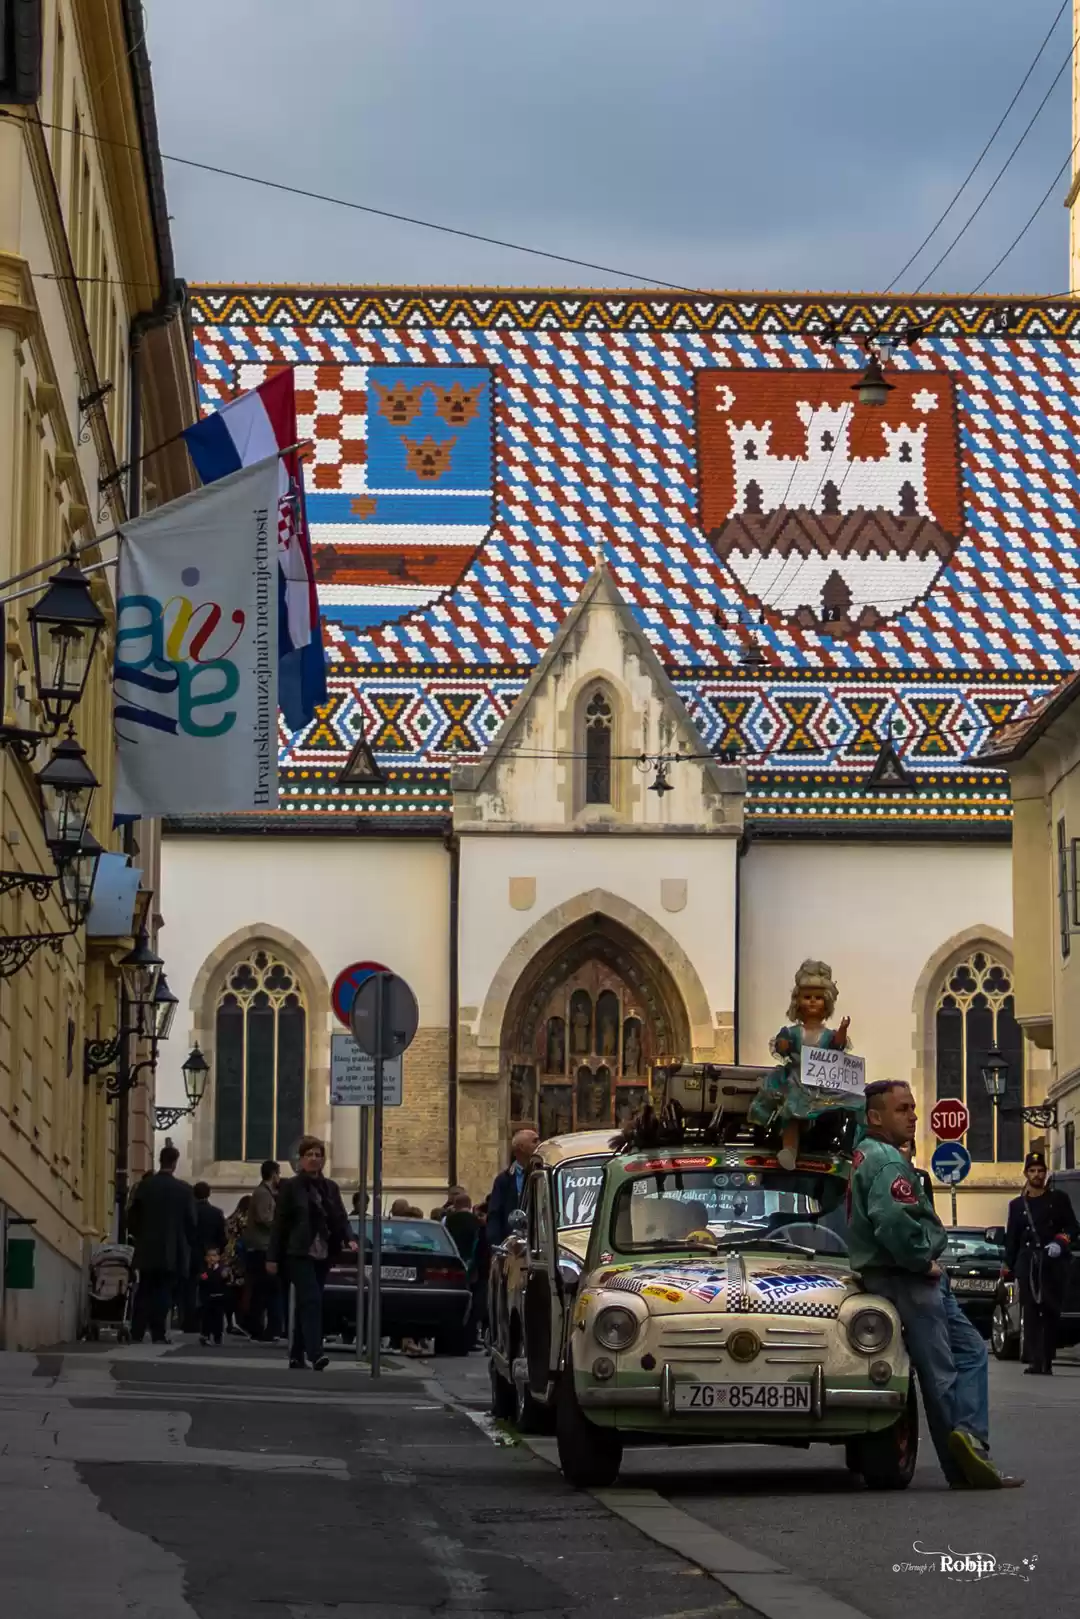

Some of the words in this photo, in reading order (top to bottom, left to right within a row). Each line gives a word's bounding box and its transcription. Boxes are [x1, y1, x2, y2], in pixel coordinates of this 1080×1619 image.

[809, 1049, 839, 1063] HALLO
[843, 1057, 863, 1072] FROM
[806, 1062, 859, 1086] ZAGREB
[932, 1110, 966, 1130] STOP
[763, 1280, 845, 1301] TRGOVINA
[689, 1385, 715, 1407] ZG
